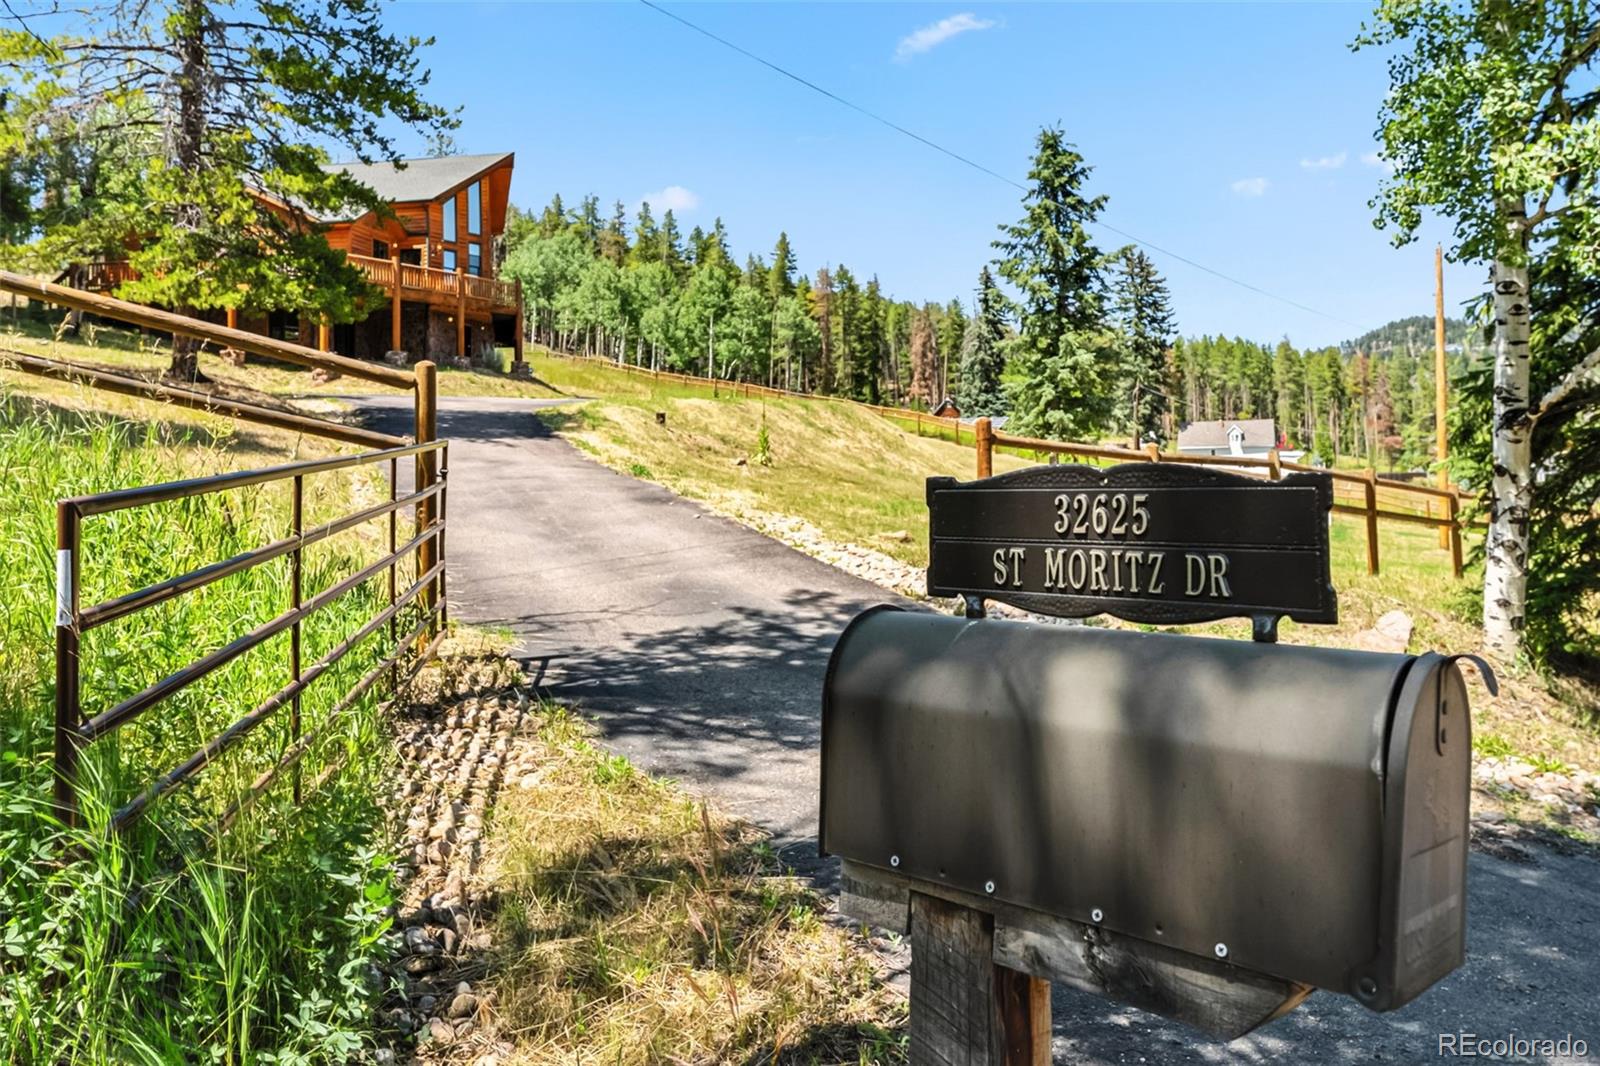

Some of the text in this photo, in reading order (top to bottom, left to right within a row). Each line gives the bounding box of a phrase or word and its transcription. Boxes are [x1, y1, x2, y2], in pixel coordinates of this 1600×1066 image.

[1053, 493, 1150, 535] 32625
[993, 547, 1231, 597] ST MORITZ DR
